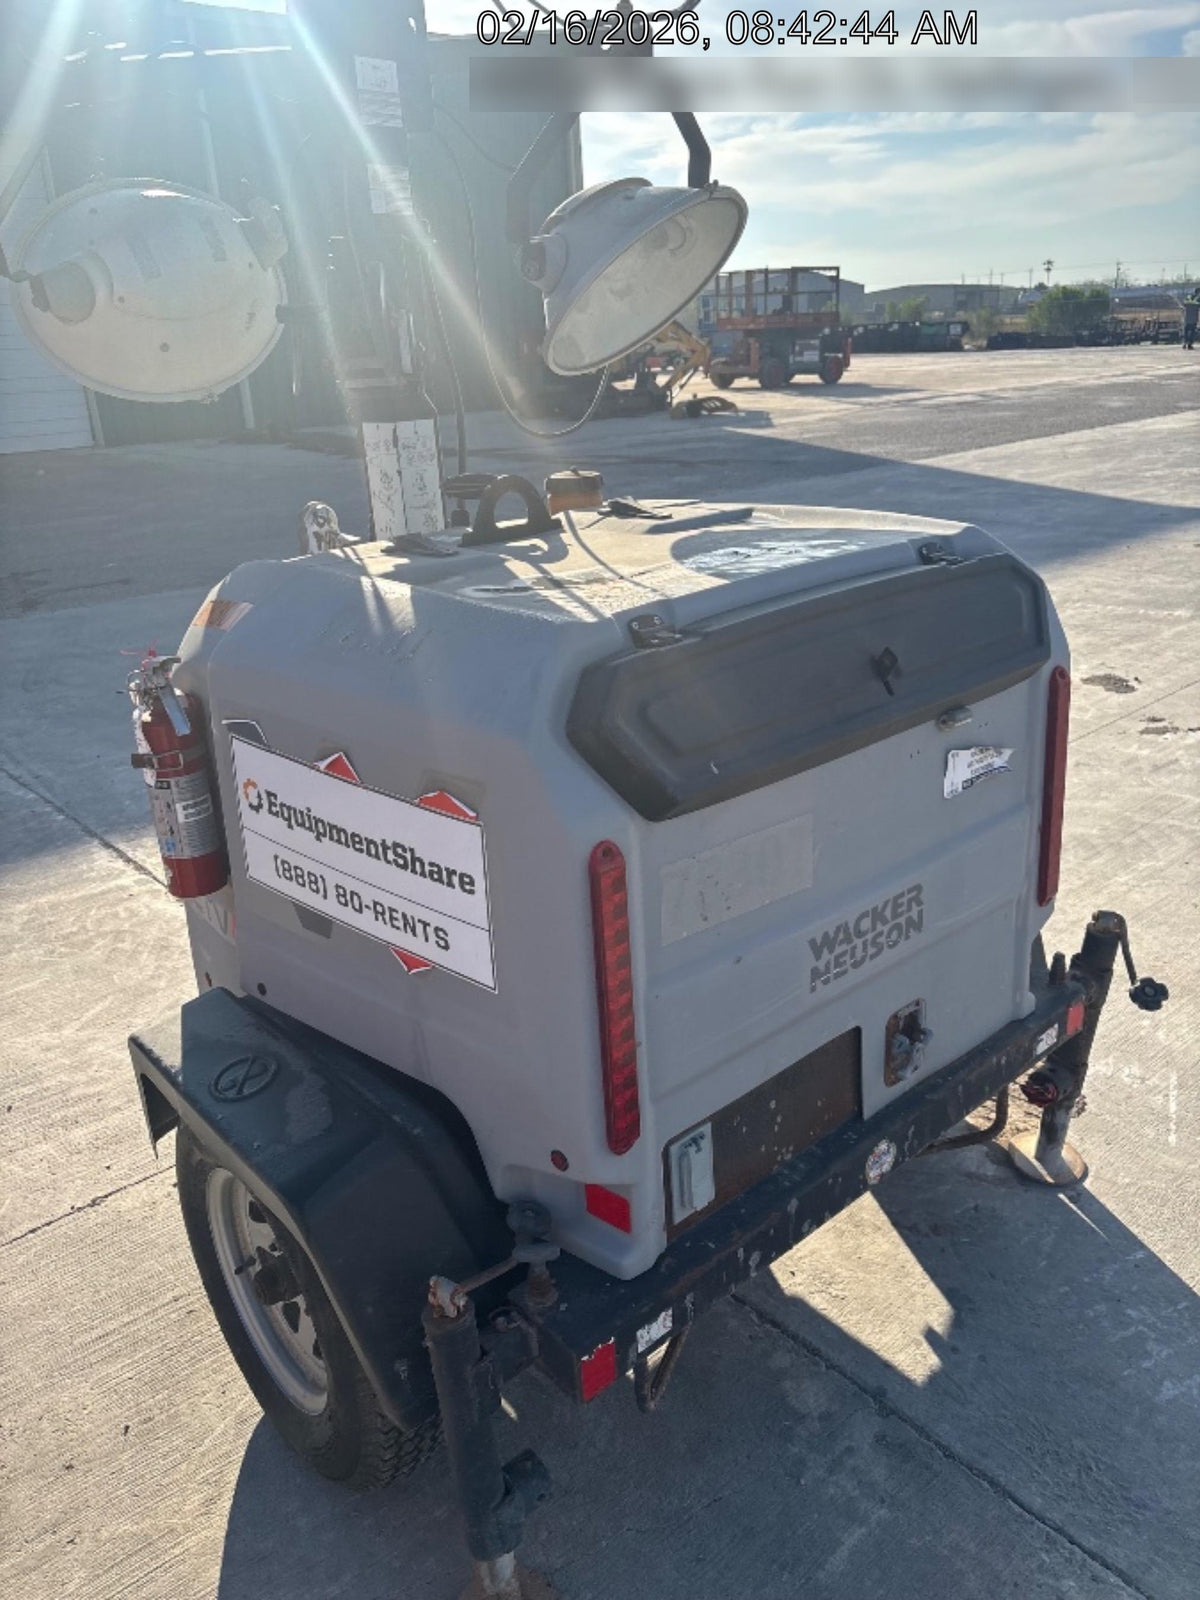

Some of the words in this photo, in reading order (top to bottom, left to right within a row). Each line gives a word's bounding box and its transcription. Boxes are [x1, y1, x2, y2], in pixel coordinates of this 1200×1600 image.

[264, 788, 476, 896] EquipmentShare
[273, 853, 328, 901] (888)
[334, 882, 451, 952] 80-RENTS
[807, 883, 924, 962] WACKER
[809, 908, 924, 994] NEUSON
